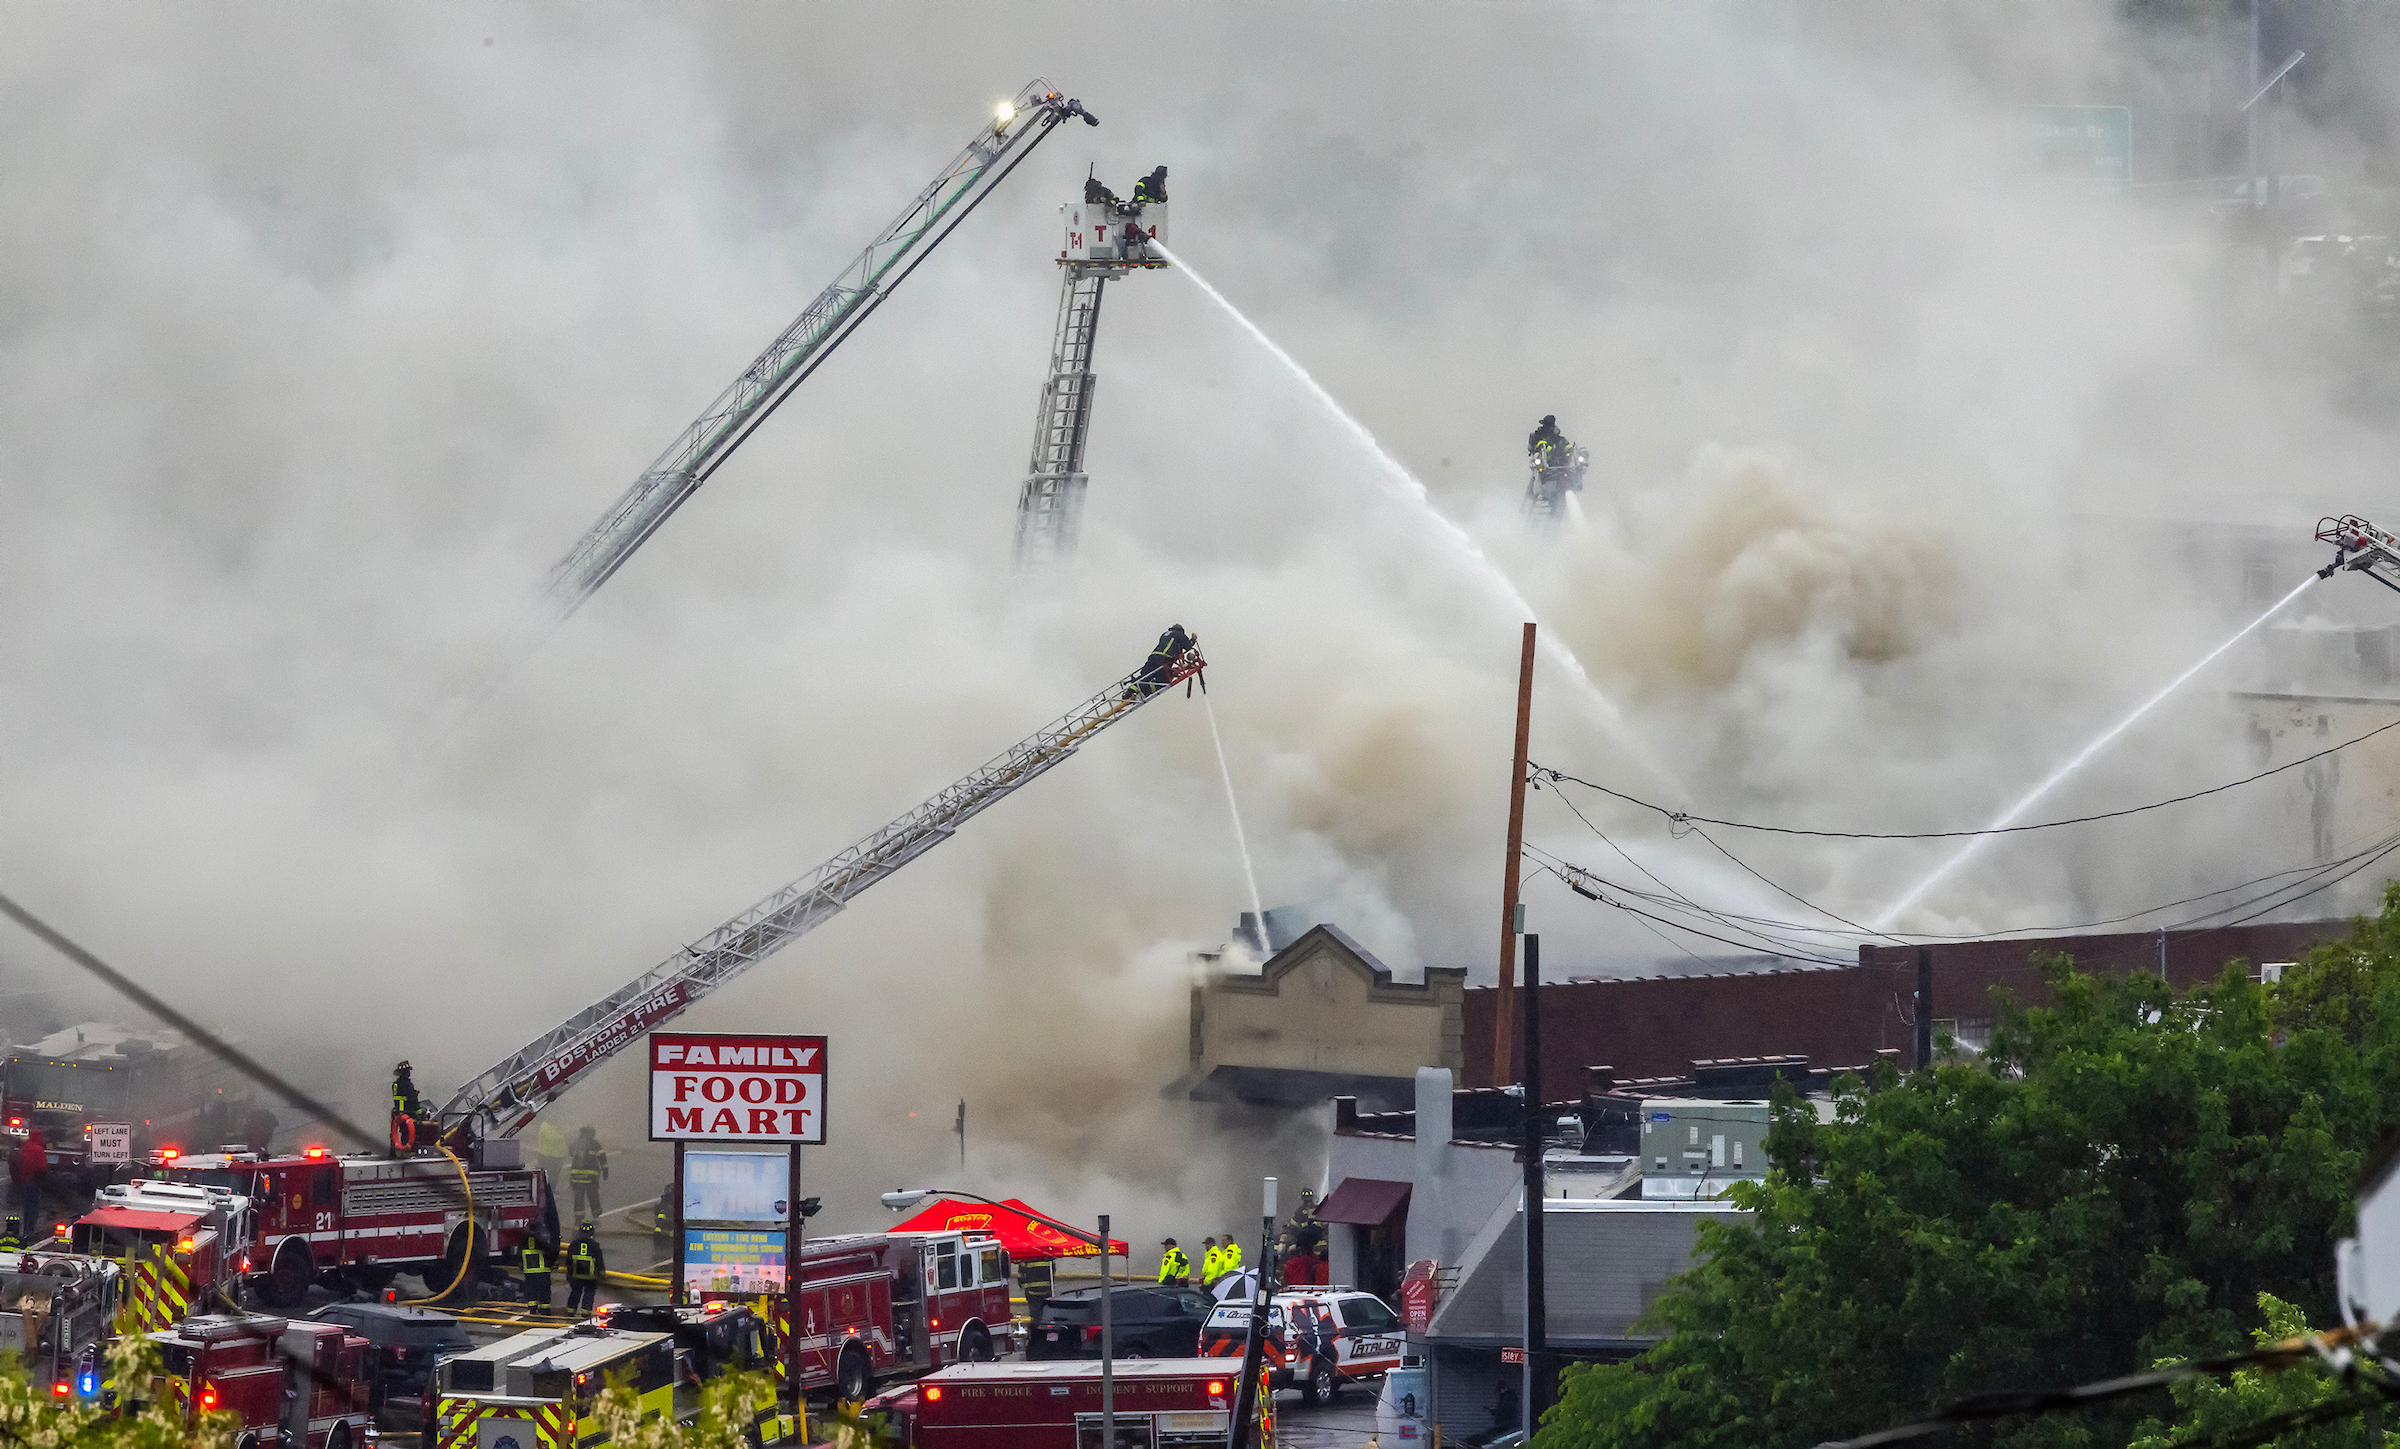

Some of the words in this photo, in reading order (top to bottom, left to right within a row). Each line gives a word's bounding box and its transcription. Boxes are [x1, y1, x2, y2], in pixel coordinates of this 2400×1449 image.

[1069, 232, 1082, 250] T-1
[1094, 225, 1107, 242] T
[543, 1018, 628, 1082] BOSTON
[632, 986, 680, 1021] FIRE
[584, 1031, 629, 1064] LADDER
[629, 1020, 646, 1034] 21
[657, 1044, 819, 1067] FAMILY
[673, 1076, 807, 1104] FOOD
[35, 1101, 84, 1112] MALDEN
[665, 1107, 812, 1135] MART
[100, 1139, 122, 1148] MUST
[690, 1161, 755, 1183] BEER
[316, 1211, 331, 1230] 21
[807, 1307, 815, 1334] 4
[961, 1388, 986, 1398] FIRE
[993, 1386, 1033, 1397] POLICE
[1086, 1384, 1137, 1395] INCDENT
[1145, 1383, 1195, 1394] SUPPORT
